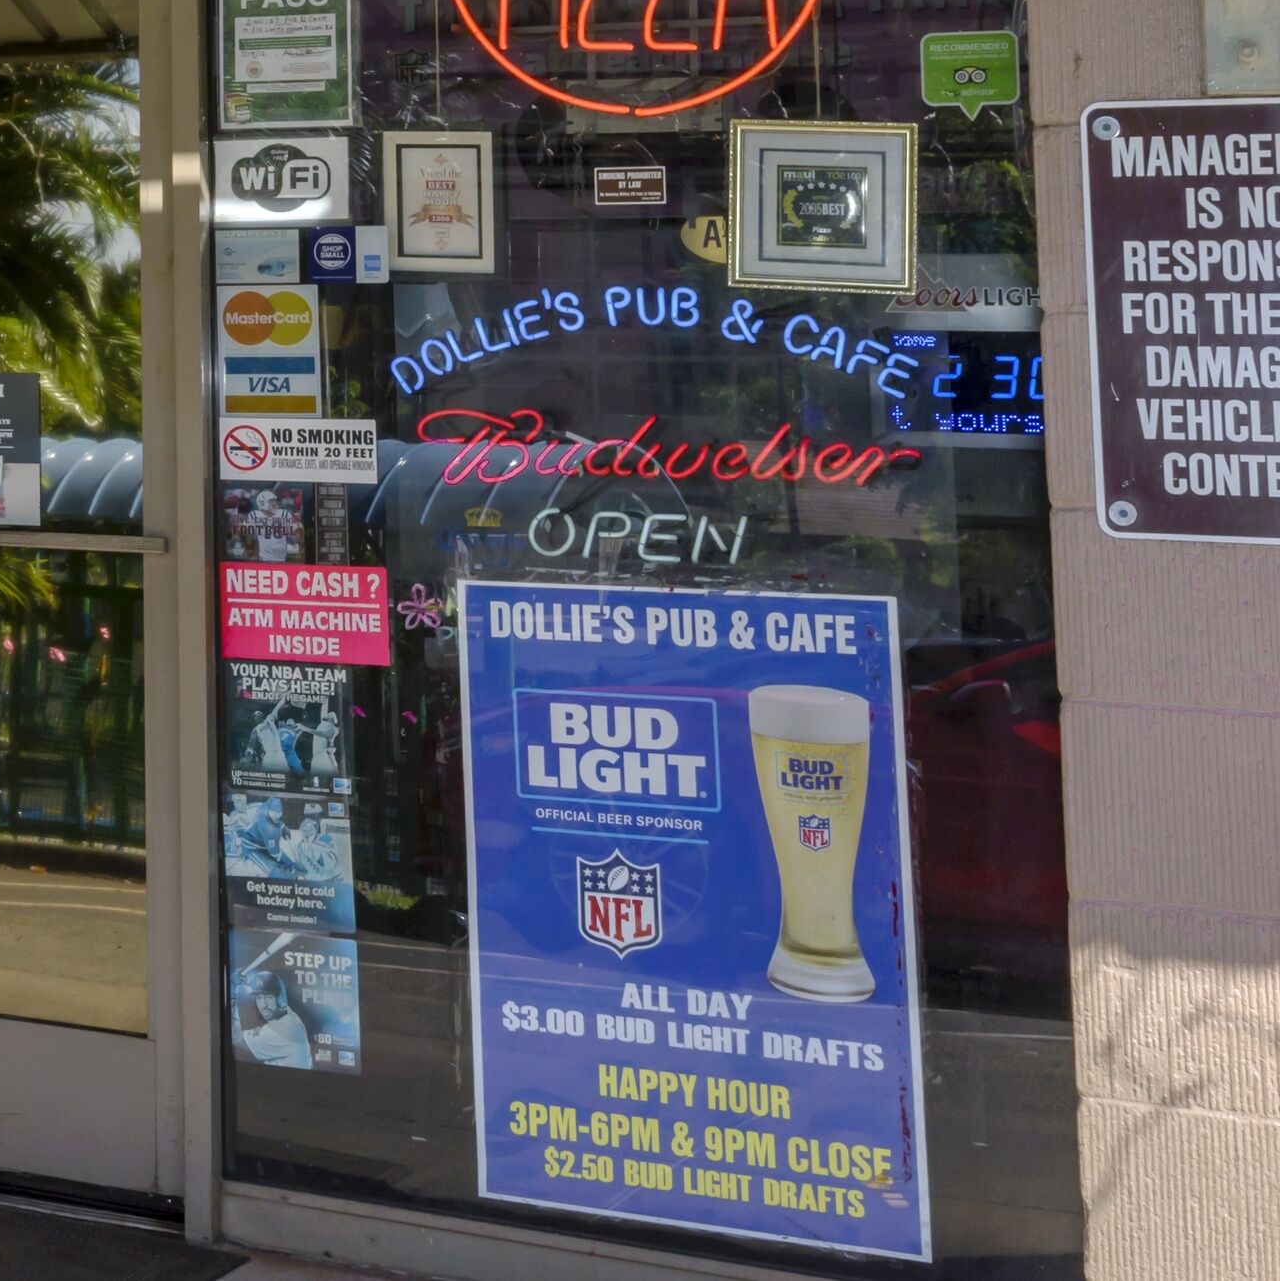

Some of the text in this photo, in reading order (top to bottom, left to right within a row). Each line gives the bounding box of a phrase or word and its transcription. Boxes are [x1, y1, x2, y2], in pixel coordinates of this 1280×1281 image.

[930, 41, 1009, 53] RECOMMENDED
[428, 180, 455, 190] BEST
[1185, 187, 1223, 229] IS
[226, 312, 309, 325] MasterCard
[1121, 292, 1280, 336] FOR THE
[390, 286, 920, 399] DOLLIE'S PUB & CAFE
[248, 377, 290, 393] VISA
[271, 428, 374, 445] NO SMOKING
[417, 408, 923, 487] Budweiser
[272, 446, 374, 458] WITHIN 20 FEET
[528, 508, 748, 565] OPEN
[226, 568, 359, 597] NEED CASH
[228, 607, 382, 633] ATM MACHINE
[647, 607, 718, 649] PUB
[729, 609, 756, 651] &
[766, 611, 858, 655] CAFE
[269, 635, 340, 656] INSIDE
[230, 663, 347, 683] YOUR NBA TEAM
[242, 677, 335, 695] PLAYS HERE!
[549, 702, 679, 751] BUD
[527, 745, 708, 798] LIGHT
[788, 757, 834, 776] BUD
[781, 772, 843, 792] LIGHT
[535, 807, 703, 831] OFFICIAL BEER SPONSOR
[801, 827, 830, 848] NFL
[247, 881, 335, 897] Get your ice cold
[256, 894, 295, 909] hockey
[587, 894, 653, 945] NFL
[284, 952, 352, 971] STEP UP
[294, 970, 352, 989] TO THE
[621, 982, 753, 1021] ALL DAY
[502, 1000, 884, 1072] $3.00 BUD LIGHT DRAFTS
[598, 1063, 791, 1120] HAPPY HOUR
[509, 1100, 893, 1185] 3PM-6PM & 9PM CLOSE
[544, 1146, 866, 1219] $2.50 BUD LIGHT DRAFTS
